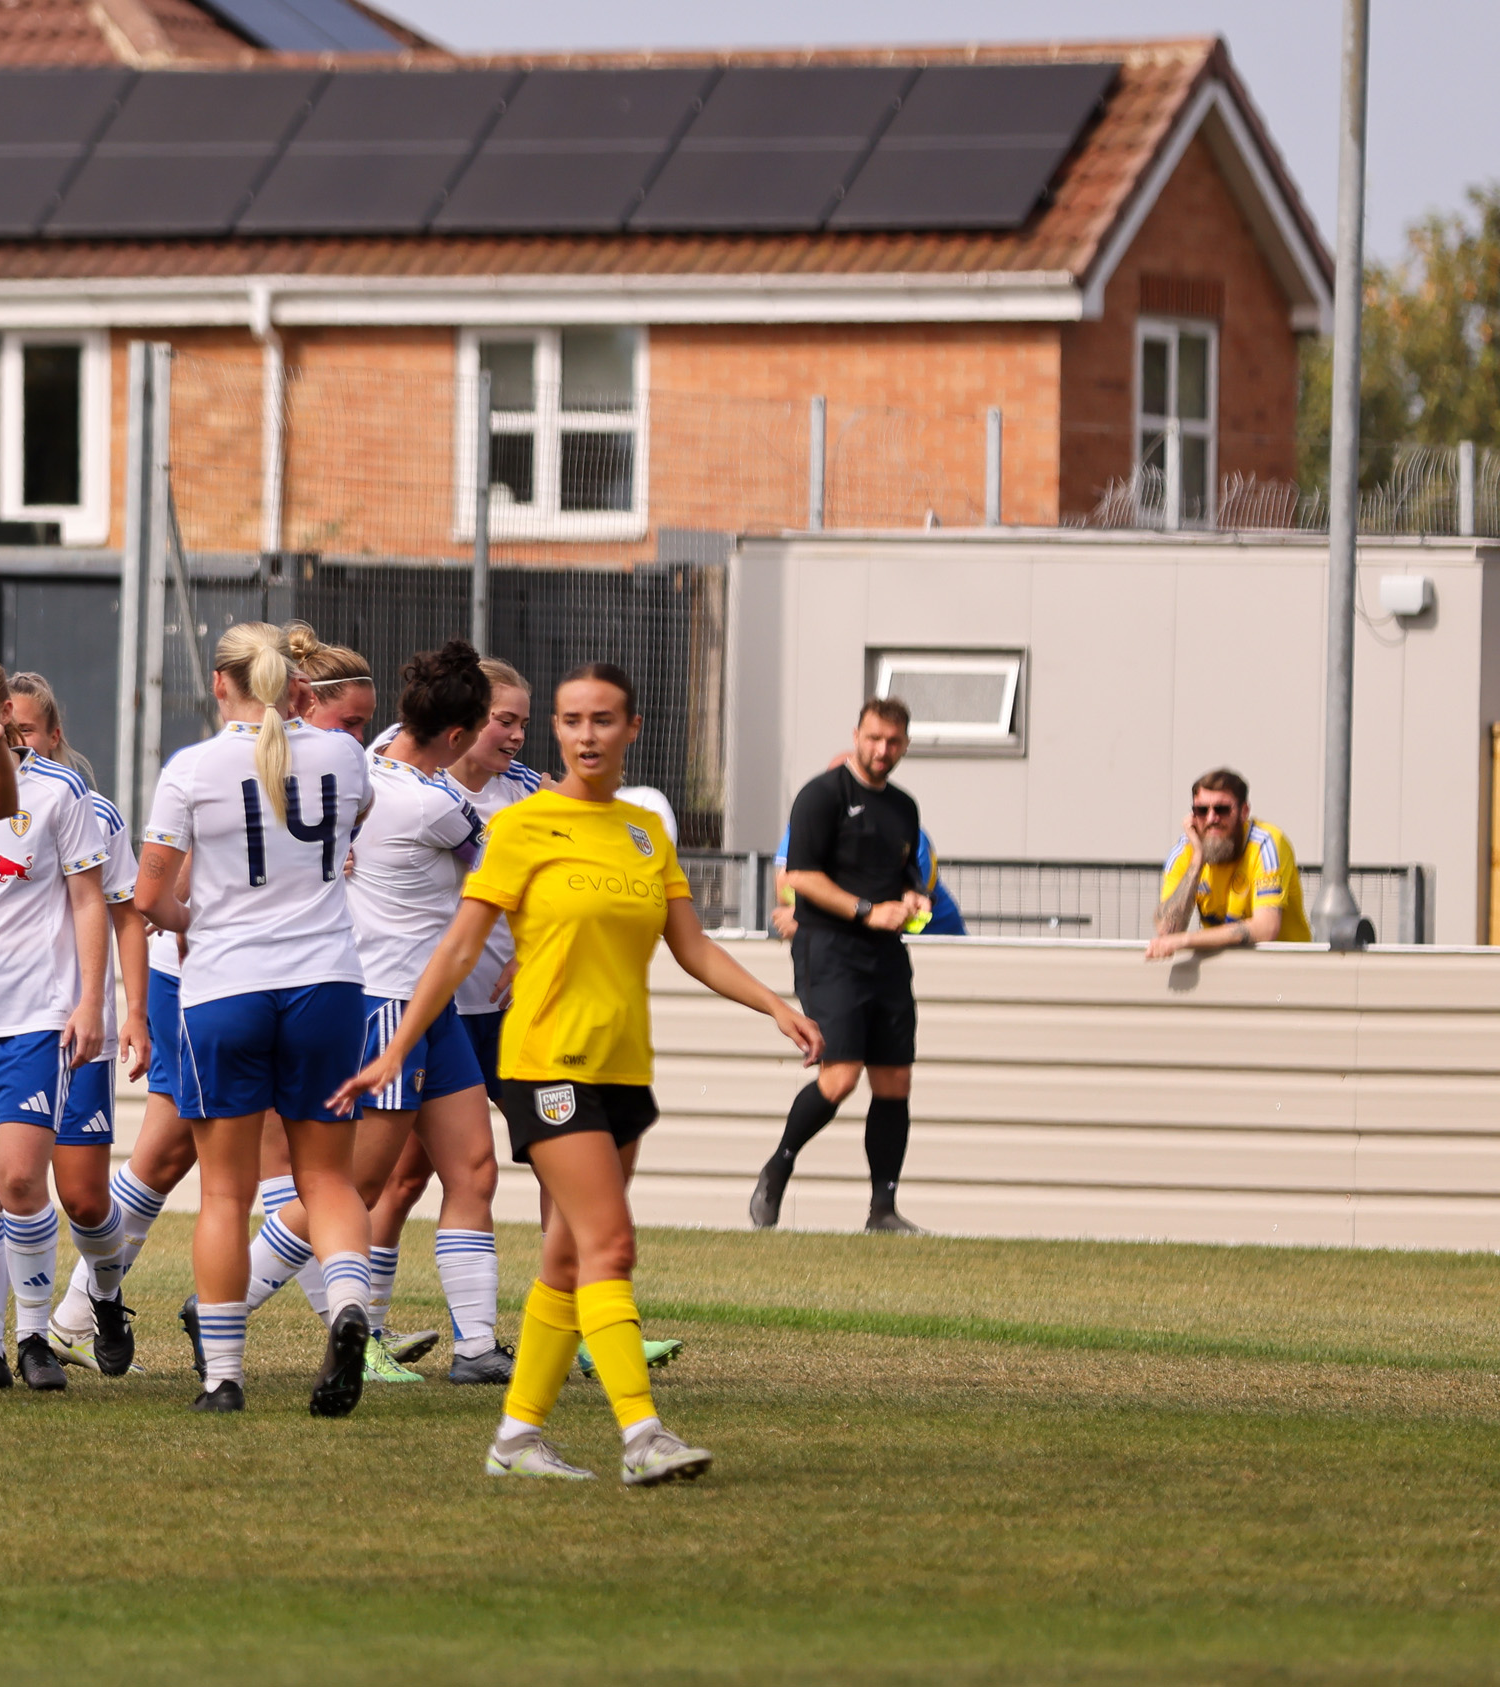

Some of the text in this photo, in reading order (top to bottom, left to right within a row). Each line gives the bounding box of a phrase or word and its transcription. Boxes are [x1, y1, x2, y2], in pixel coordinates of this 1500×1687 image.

[241, 773, 338, 888] 14
[563, 1054, 587, 1066] CWFC
[543, 1090, 571, 1104] CWFC
